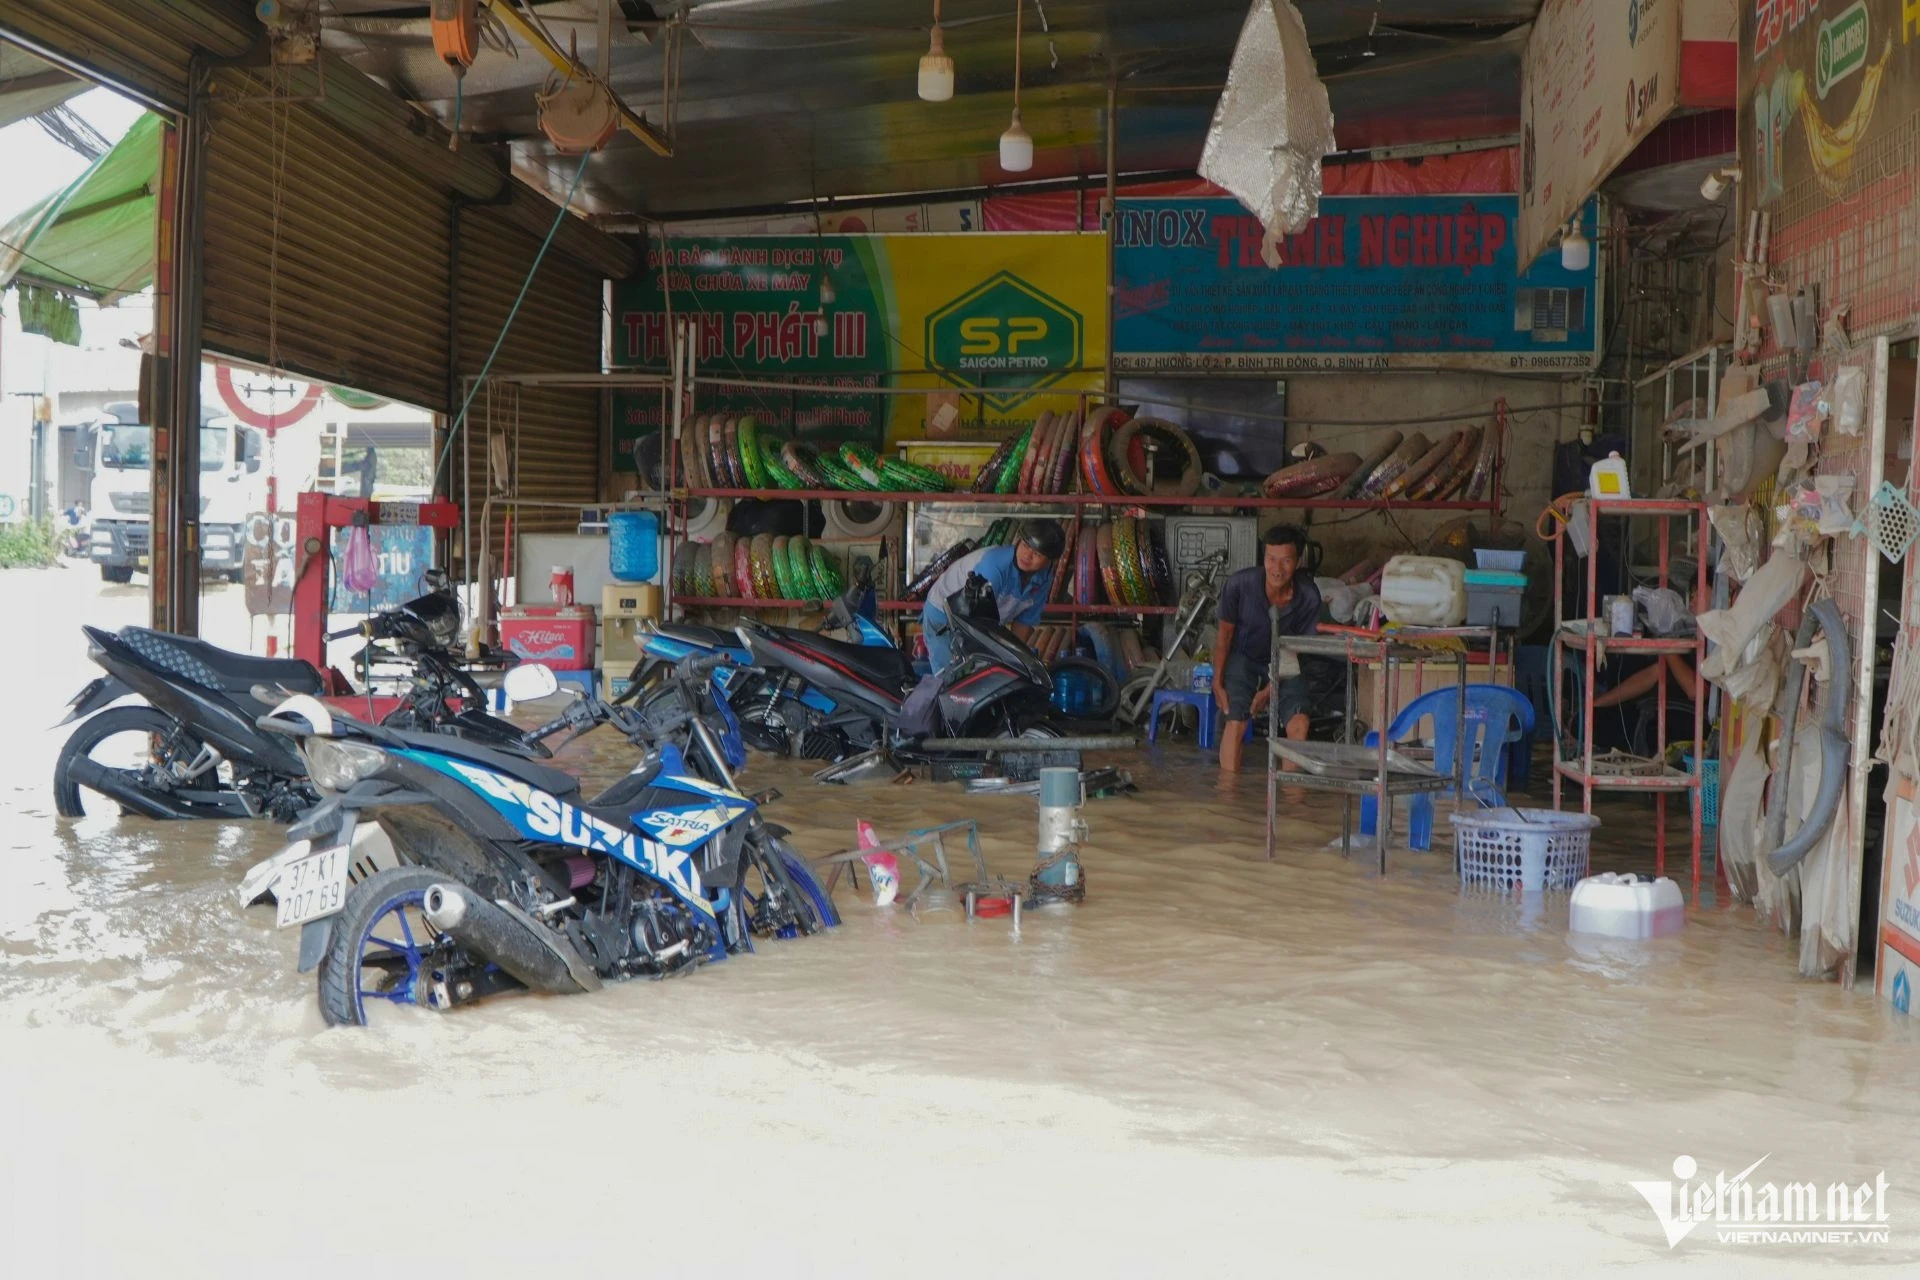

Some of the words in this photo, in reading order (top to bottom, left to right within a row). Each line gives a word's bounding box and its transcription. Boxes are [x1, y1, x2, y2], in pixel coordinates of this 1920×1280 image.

[1114, 208, 1206, 248] INOX
[1359, 201, 1507, 278] NGHIỆP
[772, 248, 815, 269] DỊCH
[623, 310, 724, 363] THNH
[732, 300, 820, 363] PHÁT
[832, 311, 867, 360] III
[960, 317, 1048, 354] SP
[960, 357, 1006, 369] SAIGON
[1008, 356, 1048, 369] PETRO
[1134, 356, 1151, 369] 487
[1237, 354, 1264, 369] BÌNH
[1338, 354, 1364, 369] BÌNH
[1530, 355, 1592, 368] 0966377352
[651, 812, 709, 832] SATRIA
[526, 788, 702, 894] SUZUKI
[1895, 897, 1920, 933] SUZUK
